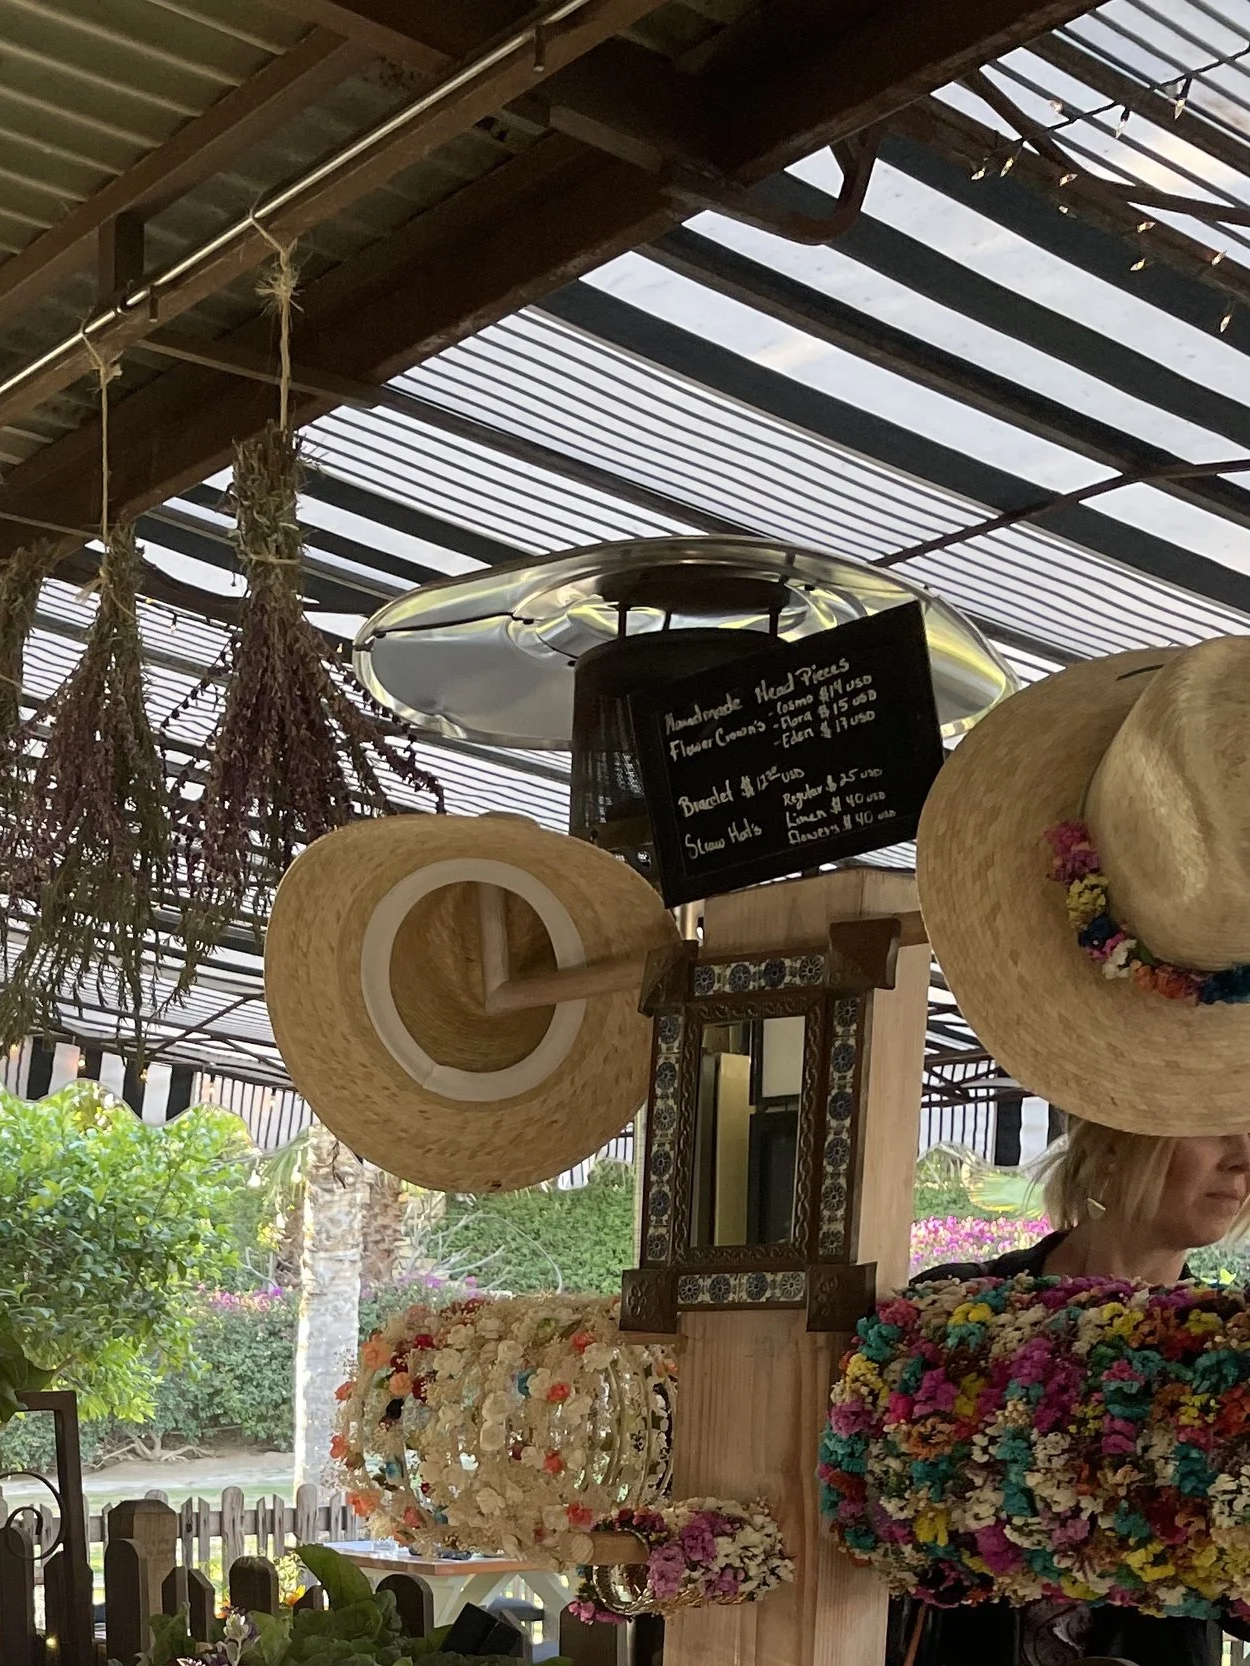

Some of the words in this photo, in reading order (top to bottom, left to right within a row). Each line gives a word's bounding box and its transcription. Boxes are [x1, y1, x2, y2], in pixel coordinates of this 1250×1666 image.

[754, 672, 795, 704] Head
[794, 657, 850, 687] Pieces
[670, 739, 714, 762] Flower
[782, 783, 823, 811] Regular
[785, 811, 827, 830] Linen
